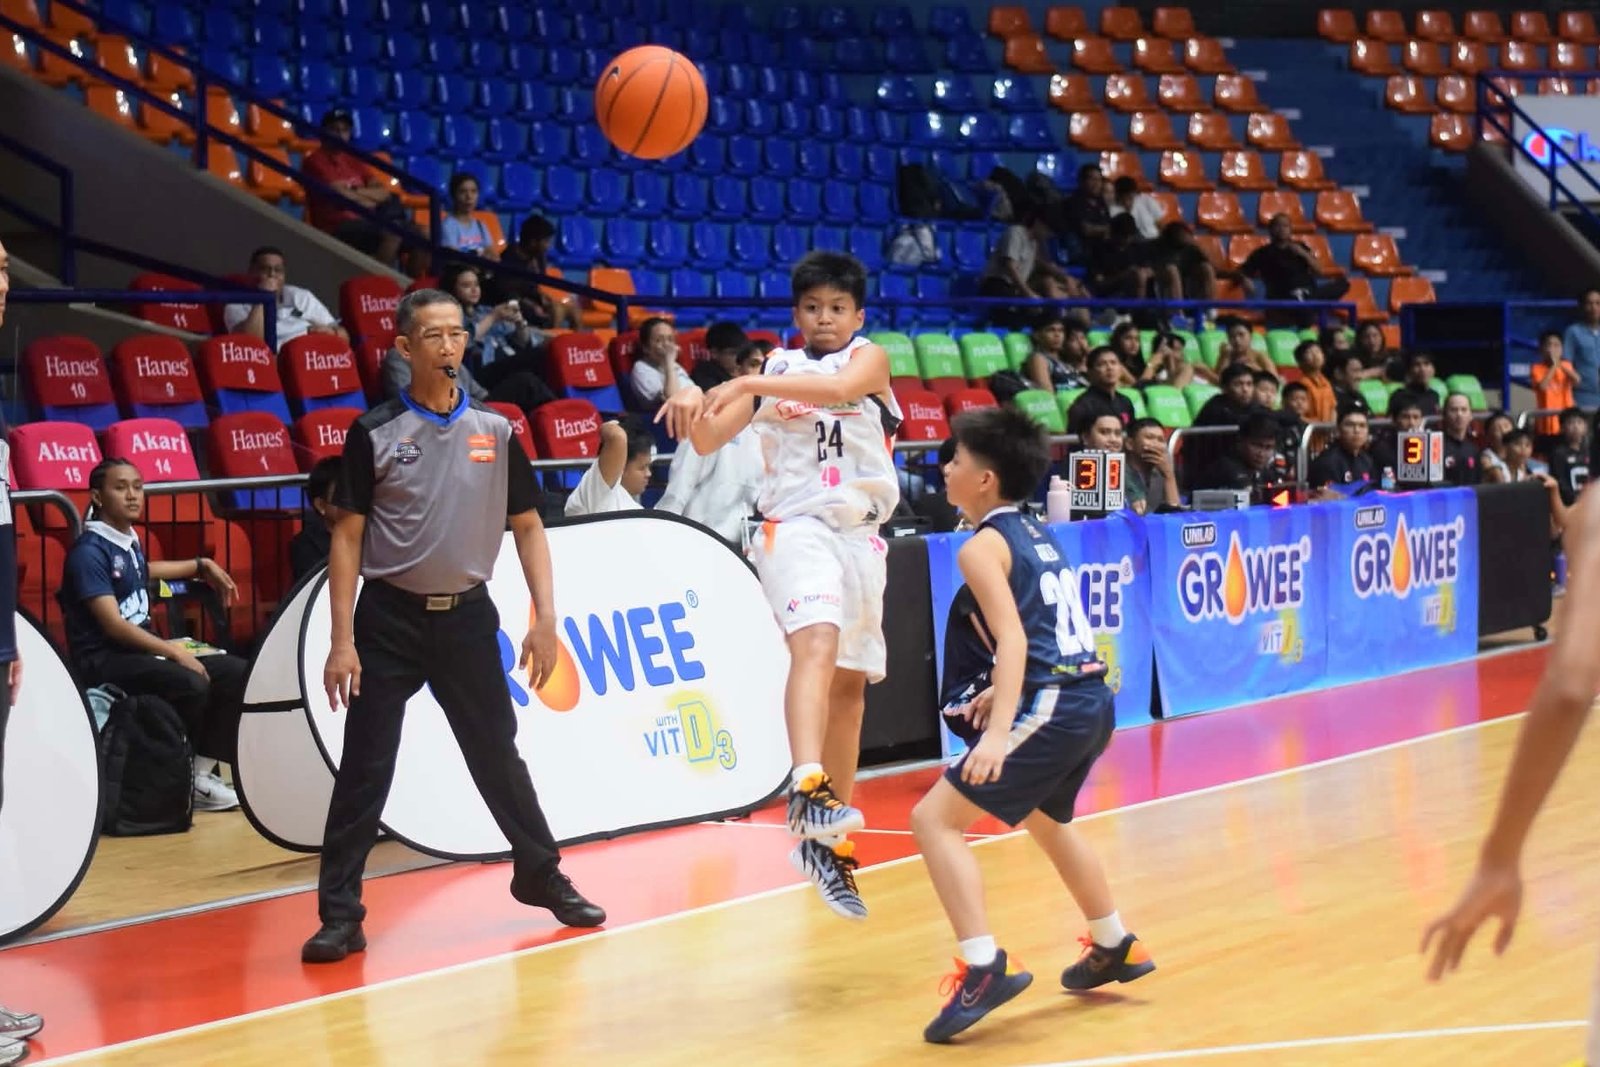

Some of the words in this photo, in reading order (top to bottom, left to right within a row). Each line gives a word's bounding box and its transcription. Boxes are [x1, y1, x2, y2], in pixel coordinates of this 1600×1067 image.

[220, 342, 270, 365] Hanes
[305, 351, 352, 371] Hanes
[567, 346, 605, 365] Hanes
[45, 355, 99, 377] Hanes
[136, 356, 189, 377] Hanes
[247, 368, 256, 385] 8
[331, 375, 340, 390] 7
[70, 382, 87, 399] 10
[166, 382, 175, 397] 9
[554, 416, 599, 438] Hanes
[131, 431, 187, 454] Akari
[231, 428, 285, 451] Hanes
[815, 420, 844, 463] 24
[38, 441, 98, 463] Akari
[1407, 437, 1423, 464] 3
[155, 458, 172, 475] 14
[260, 455, 269, 471] 1
[64, 466, 82, 484] 15
[1080, 459, 1097, 489] 3
[1072, 491, 1099, 507] FOUL
[1184, 525, 1215, 545] UNILAB
[1354, 519, 1457, 594] GROWEE
[1179, 536, 1302, 618] GROWEE
[655, 715, 679, 728] WITH
